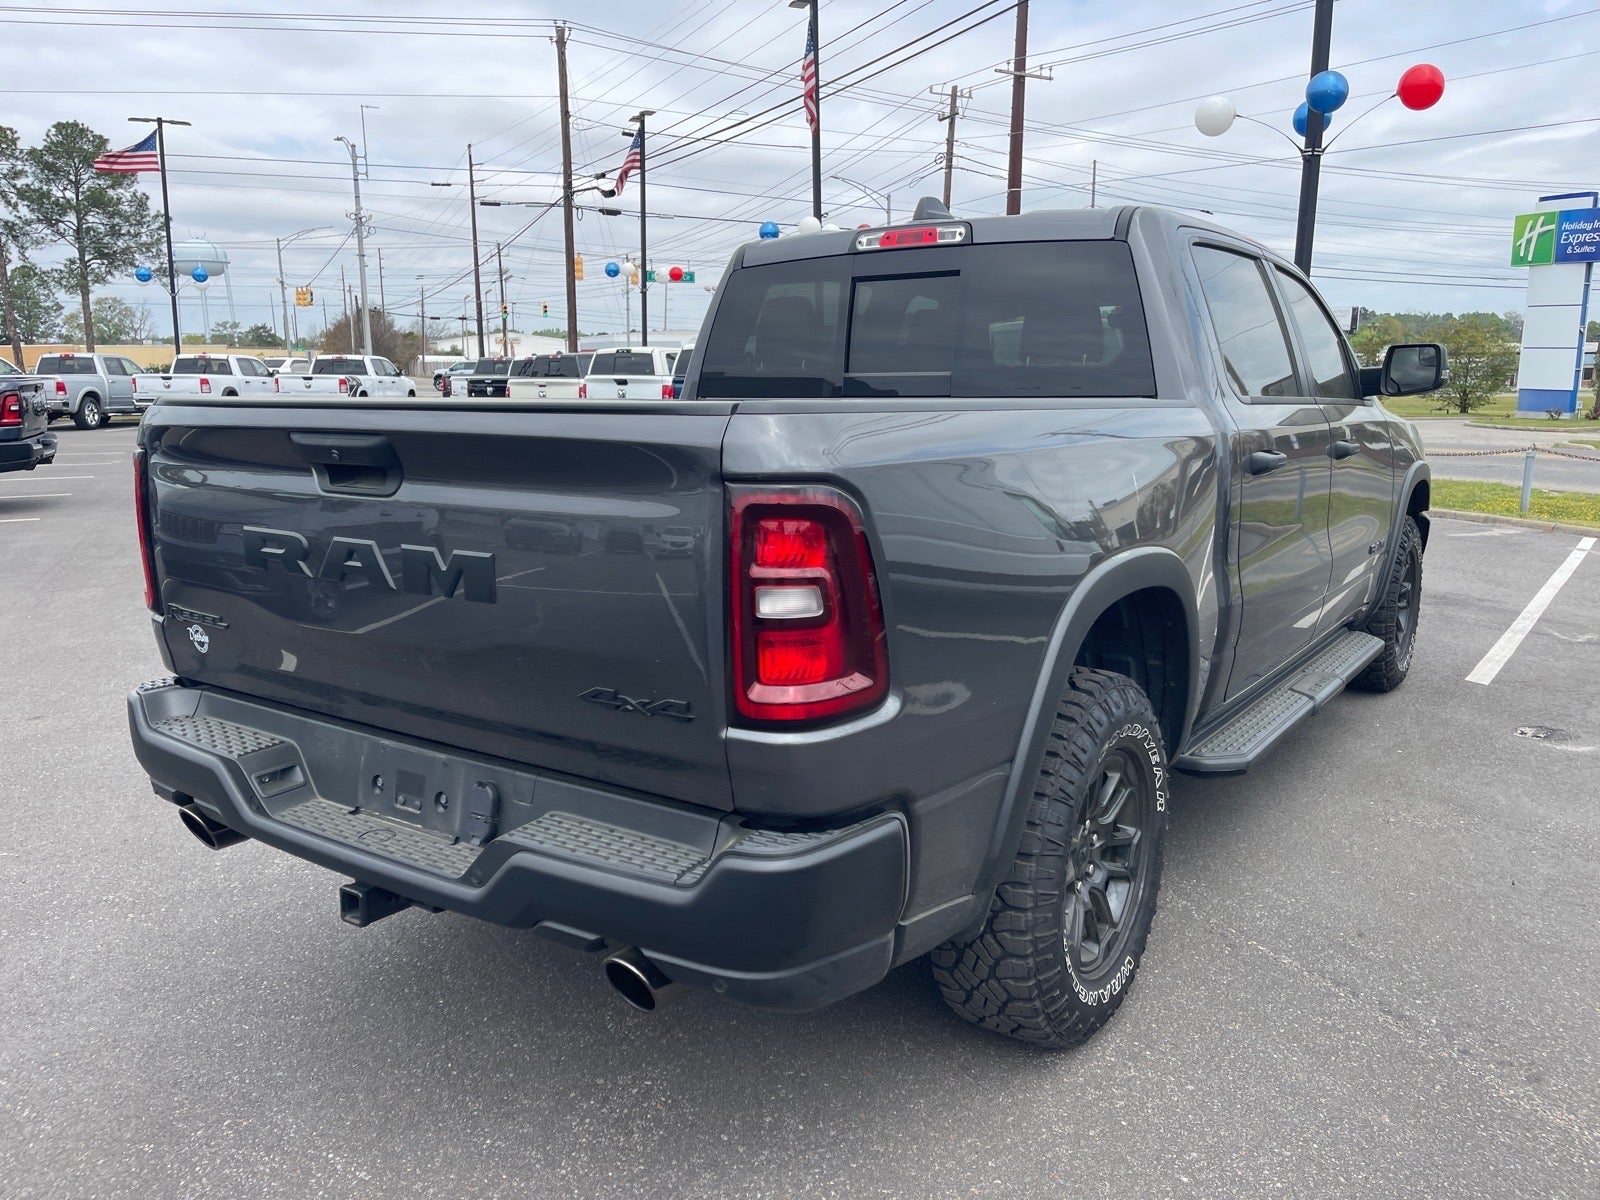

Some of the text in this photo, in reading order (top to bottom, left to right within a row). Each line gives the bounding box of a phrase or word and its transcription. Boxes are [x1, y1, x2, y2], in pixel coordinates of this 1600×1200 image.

[1562, 221, 1593, 231] Holiday
[1560, 232, 1600, 245] Expres
[1566, 245, 1596, 254] & Suites
[242, 525, 497, 605] RAM
[1098, 723, 1165, 812] GOODYEAR
